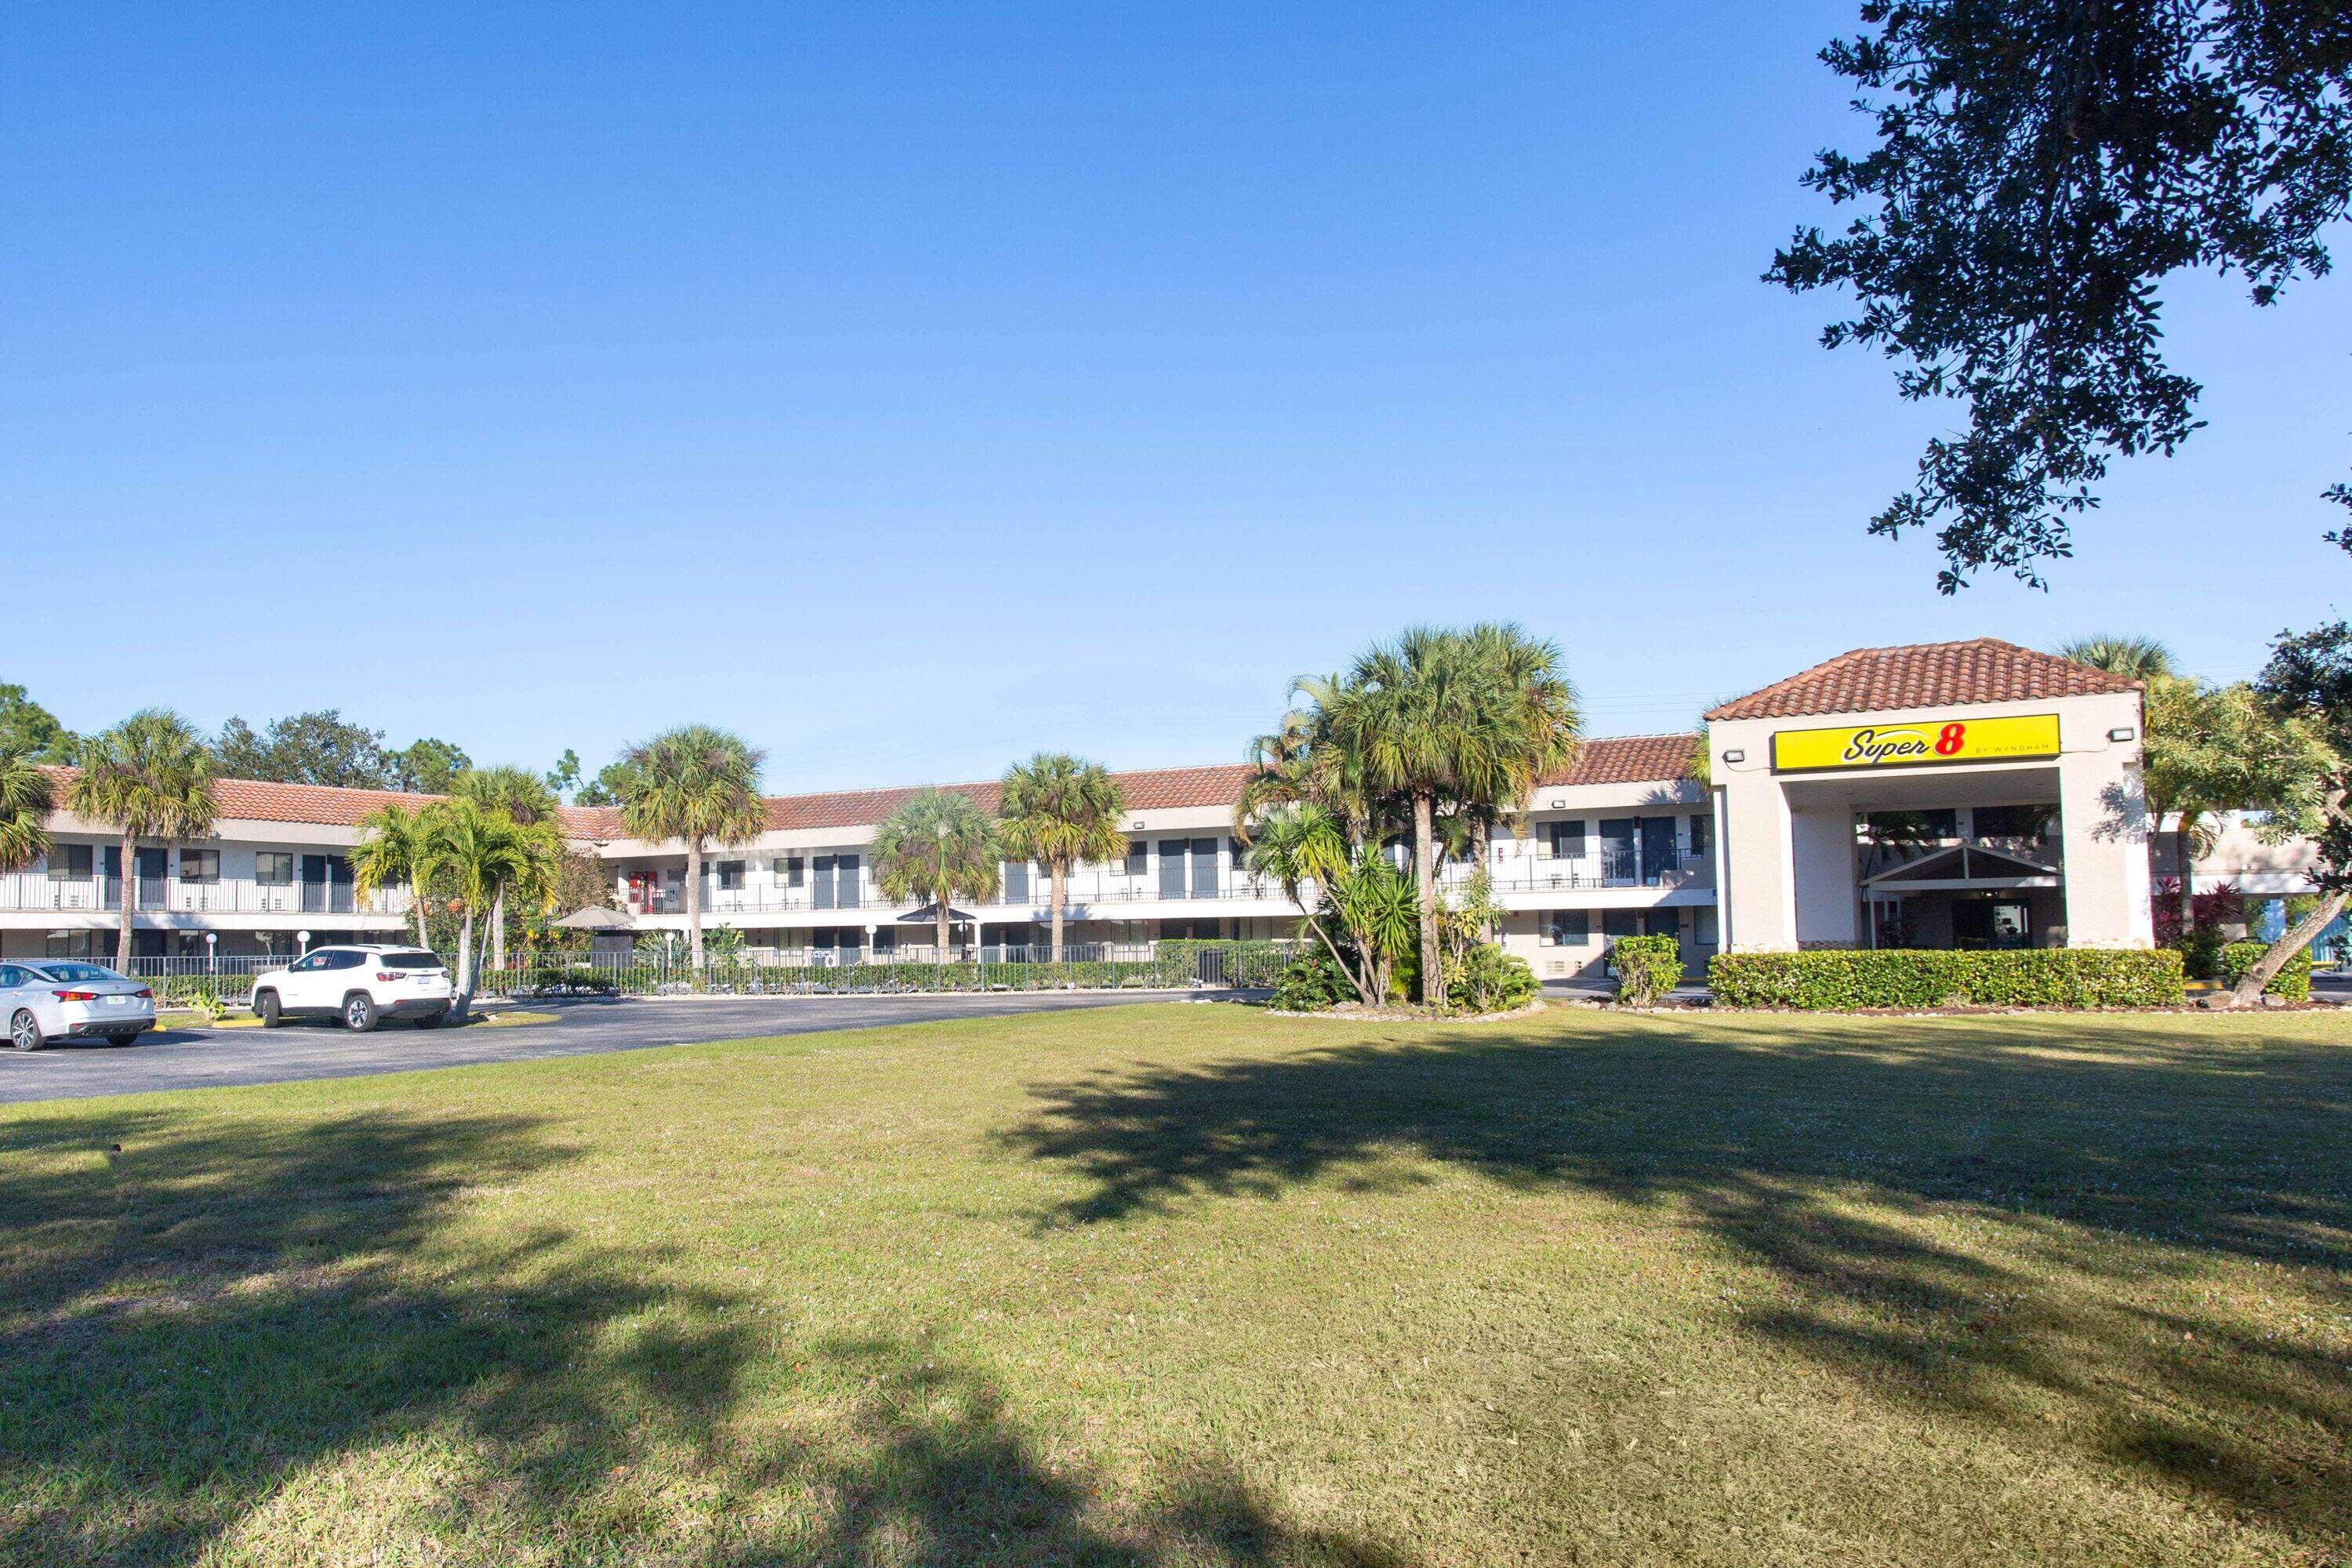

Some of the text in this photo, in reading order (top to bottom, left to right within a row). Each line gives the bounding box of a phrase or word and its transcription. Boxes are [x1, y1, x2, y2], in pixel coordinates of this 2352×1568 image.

[1843, 723, 1965, 764] Super 8
[1994, 744, 2049, 753] WYNDHAM
